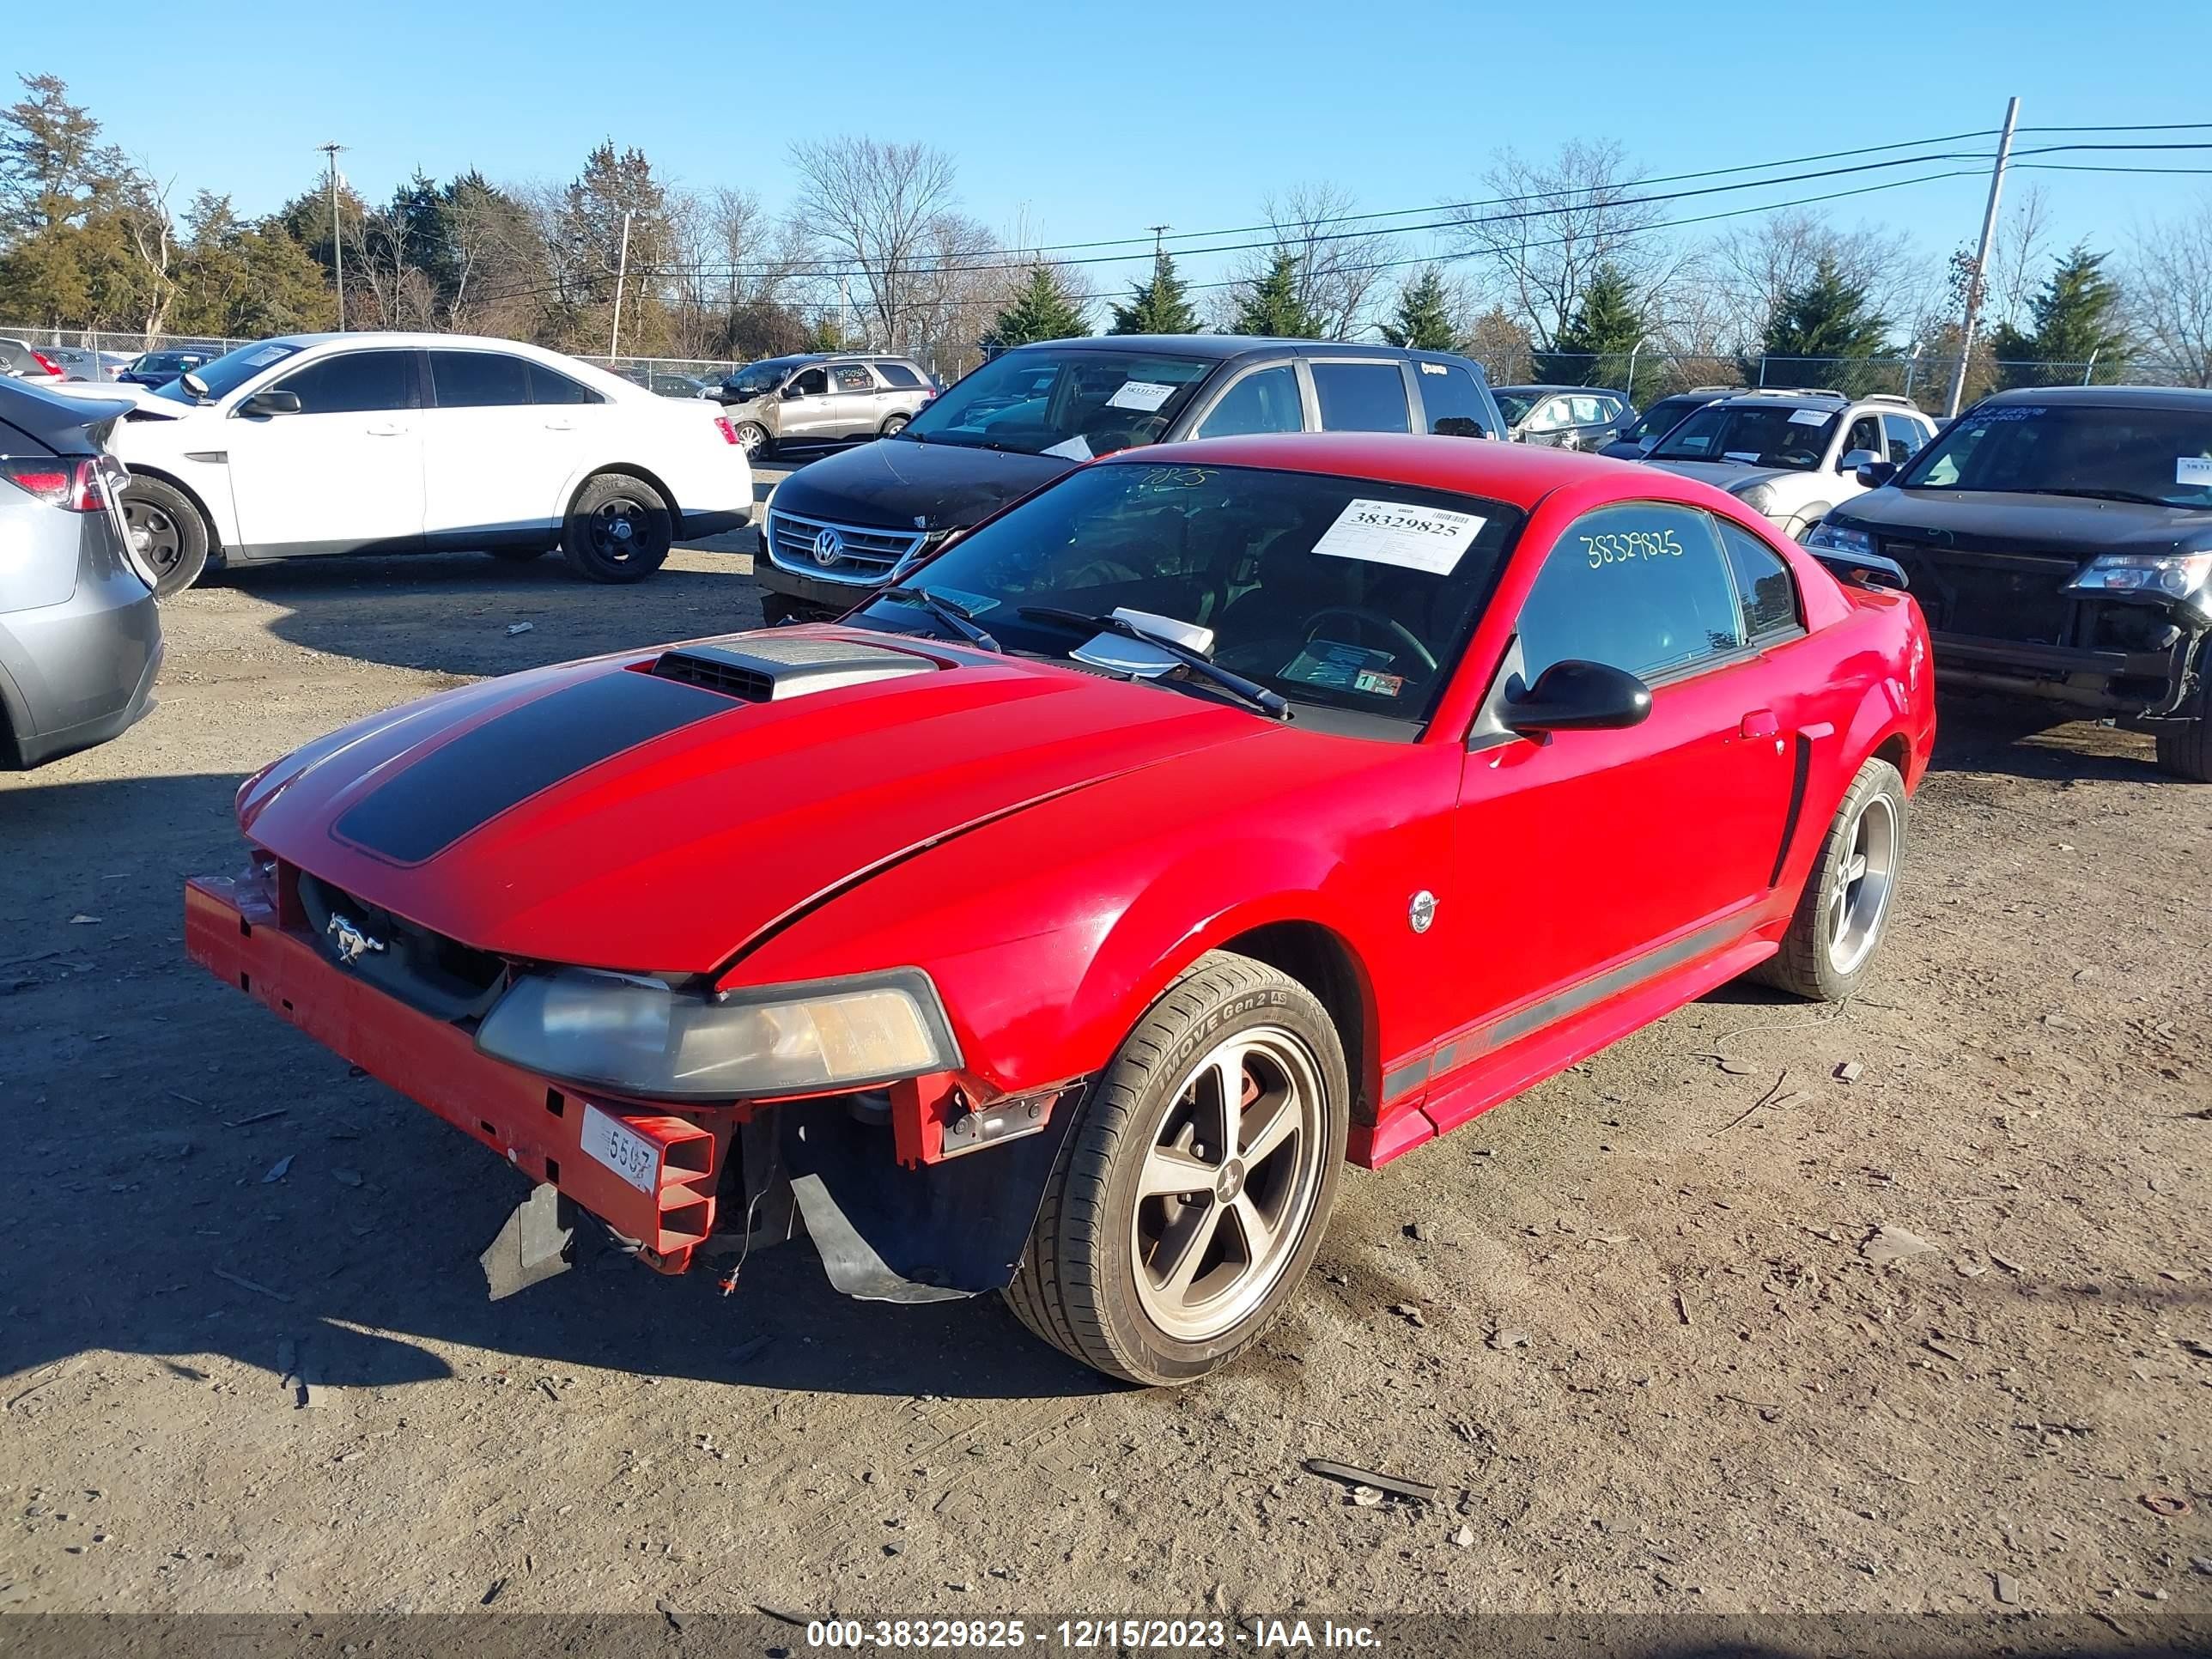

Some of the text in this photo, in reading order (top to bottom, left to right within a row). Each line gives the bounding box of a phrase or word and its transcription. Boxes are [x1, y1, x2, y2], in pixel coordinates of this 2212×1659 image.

[1350, 512, 1461, 538] 38329825
[1579, 529, 1683, 568] 38329825
[1222, 998, 1255, 1019] Gen
[1256, 993, 1267, 1006] 2
[1272, 991, 1286, 1005] AS
